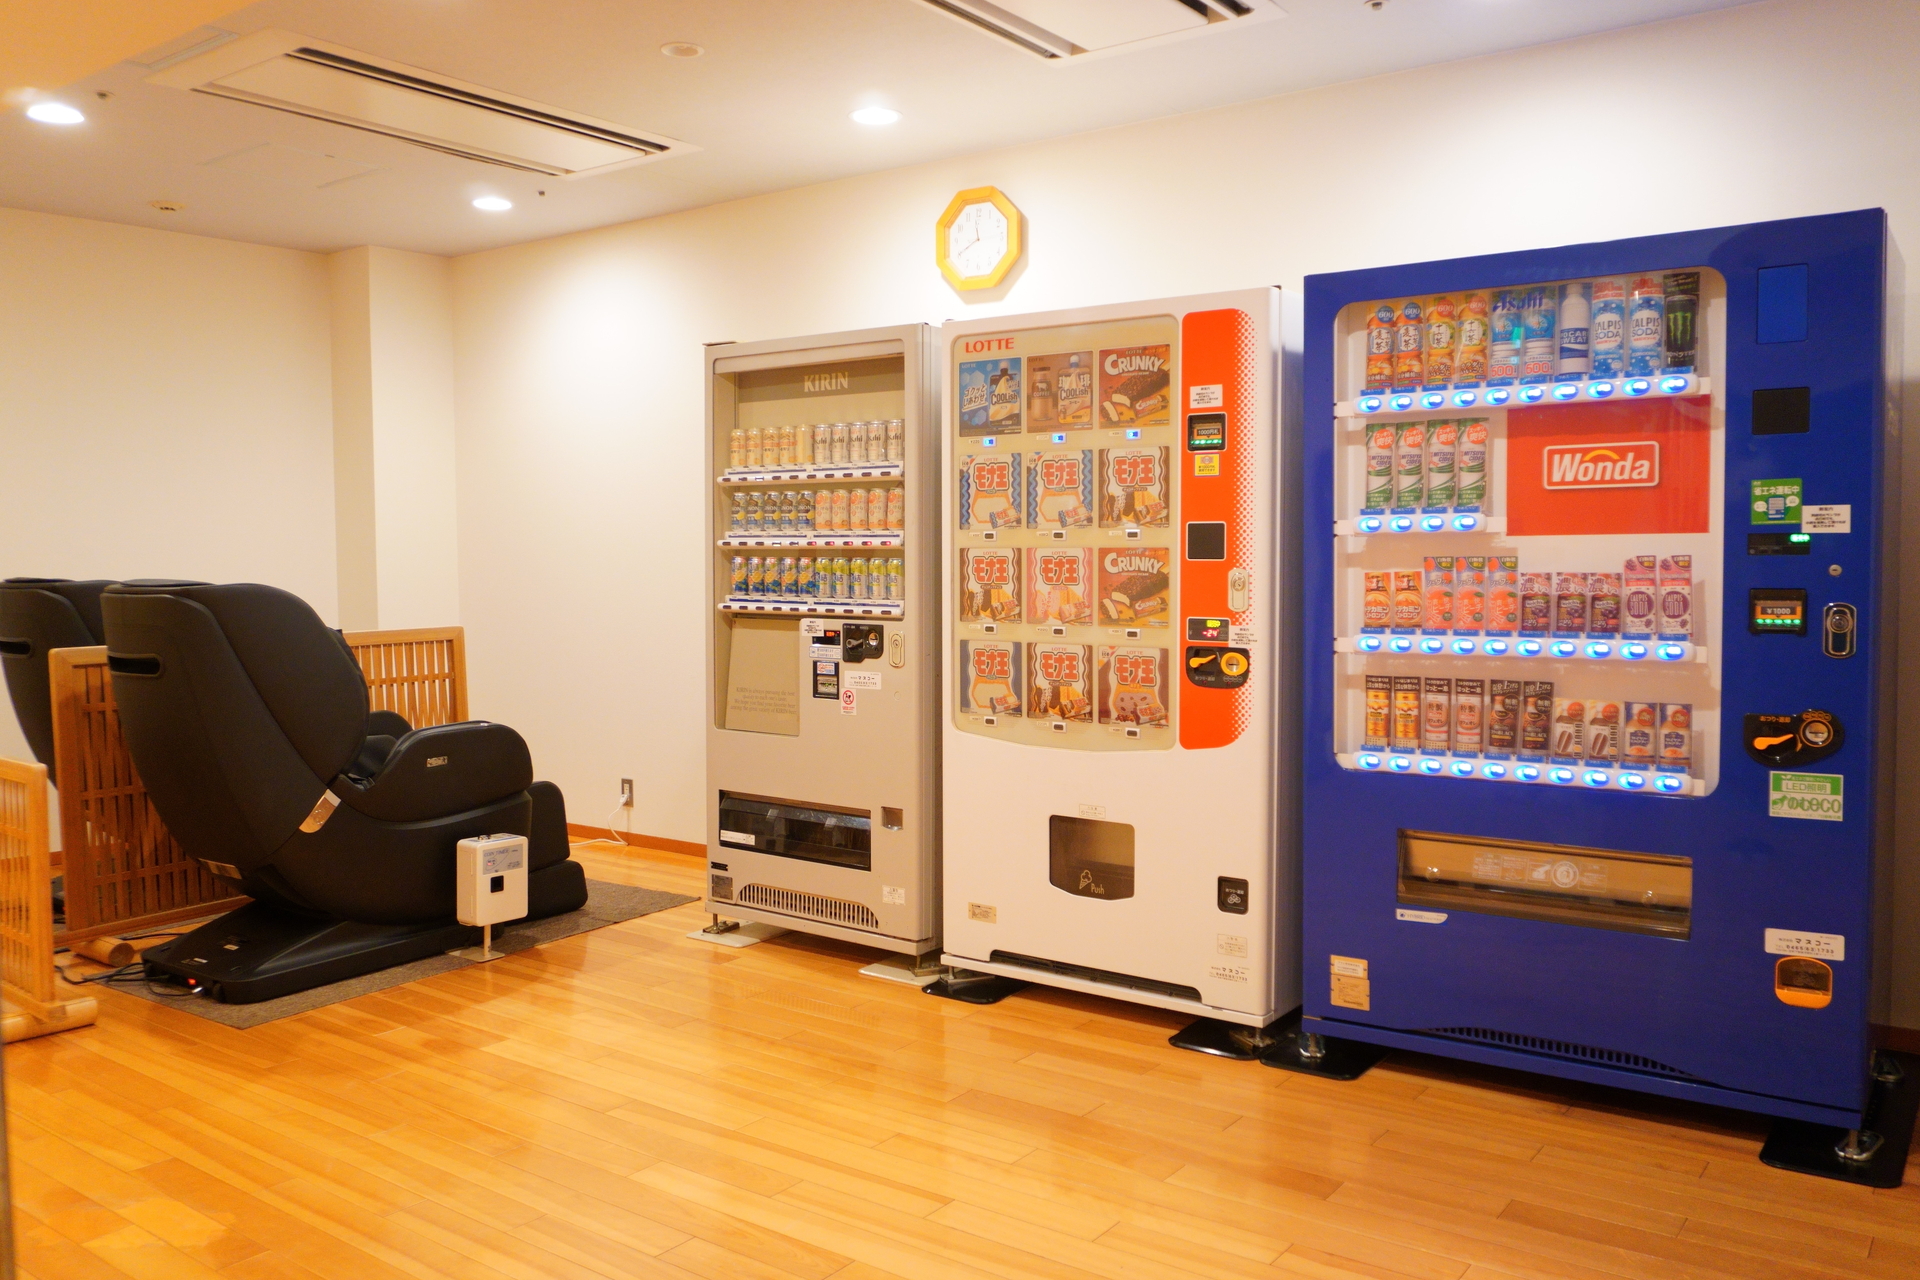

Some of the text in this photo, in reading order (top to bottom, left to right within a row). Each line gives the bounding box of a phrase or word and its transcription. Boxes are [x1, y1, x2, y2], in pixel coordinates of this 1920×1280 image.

[1492, 292, 1544, 312] Asahi
[1466, 320, 1478, 344] 十六茶
[1595, 320, 1622, 332] CALPIS
[1632, 318, 1660, 330] CALPIS
[1434, 323, 1444, 347] 十六茶
[1595, 330, 1621, 340] SODA
[1632, 328, 1660, 338] SODA
[965, 338, 1014, 353] LOTTE
[1104, 353, 1166, 376] CRUNKY
[804, 372, 849, 392] KIRIN
[991, 392, 1018, 405] COOLish
[1060, 388, 1089, 401] COOLish
[1042, 460, 1080, 489] モナ王
[1113, 456, 1156, 486] モナ王
[1551, 452, 1650, 482] Wonda
[974, 463, 1009, 491] モナ王
[1754, 486, 1800, 496] 省エネ運転中
[973, 556, 1009, 584] モナ王
[1040, 556, 1080, 586] モナ王
[1104, 552, 1166, 574] CRUNKY
[1630, 602, 1649, 616] SODA
[1666, 602, 1684, 616] SODA
[974, 648, 1010, 679] モナ王
[1040, 652, 1080, 682] モナ王
[1114, 655, 1157, 687] モナ王
[1428, 704, 1443, 712] 特製
[1460, 705, 1476, 714] 特製
[1786, 782, 1828, 792] LED照明
[1090, 883, 1105, 895] Push
[1795, 938, 1830, 946] マスコー
